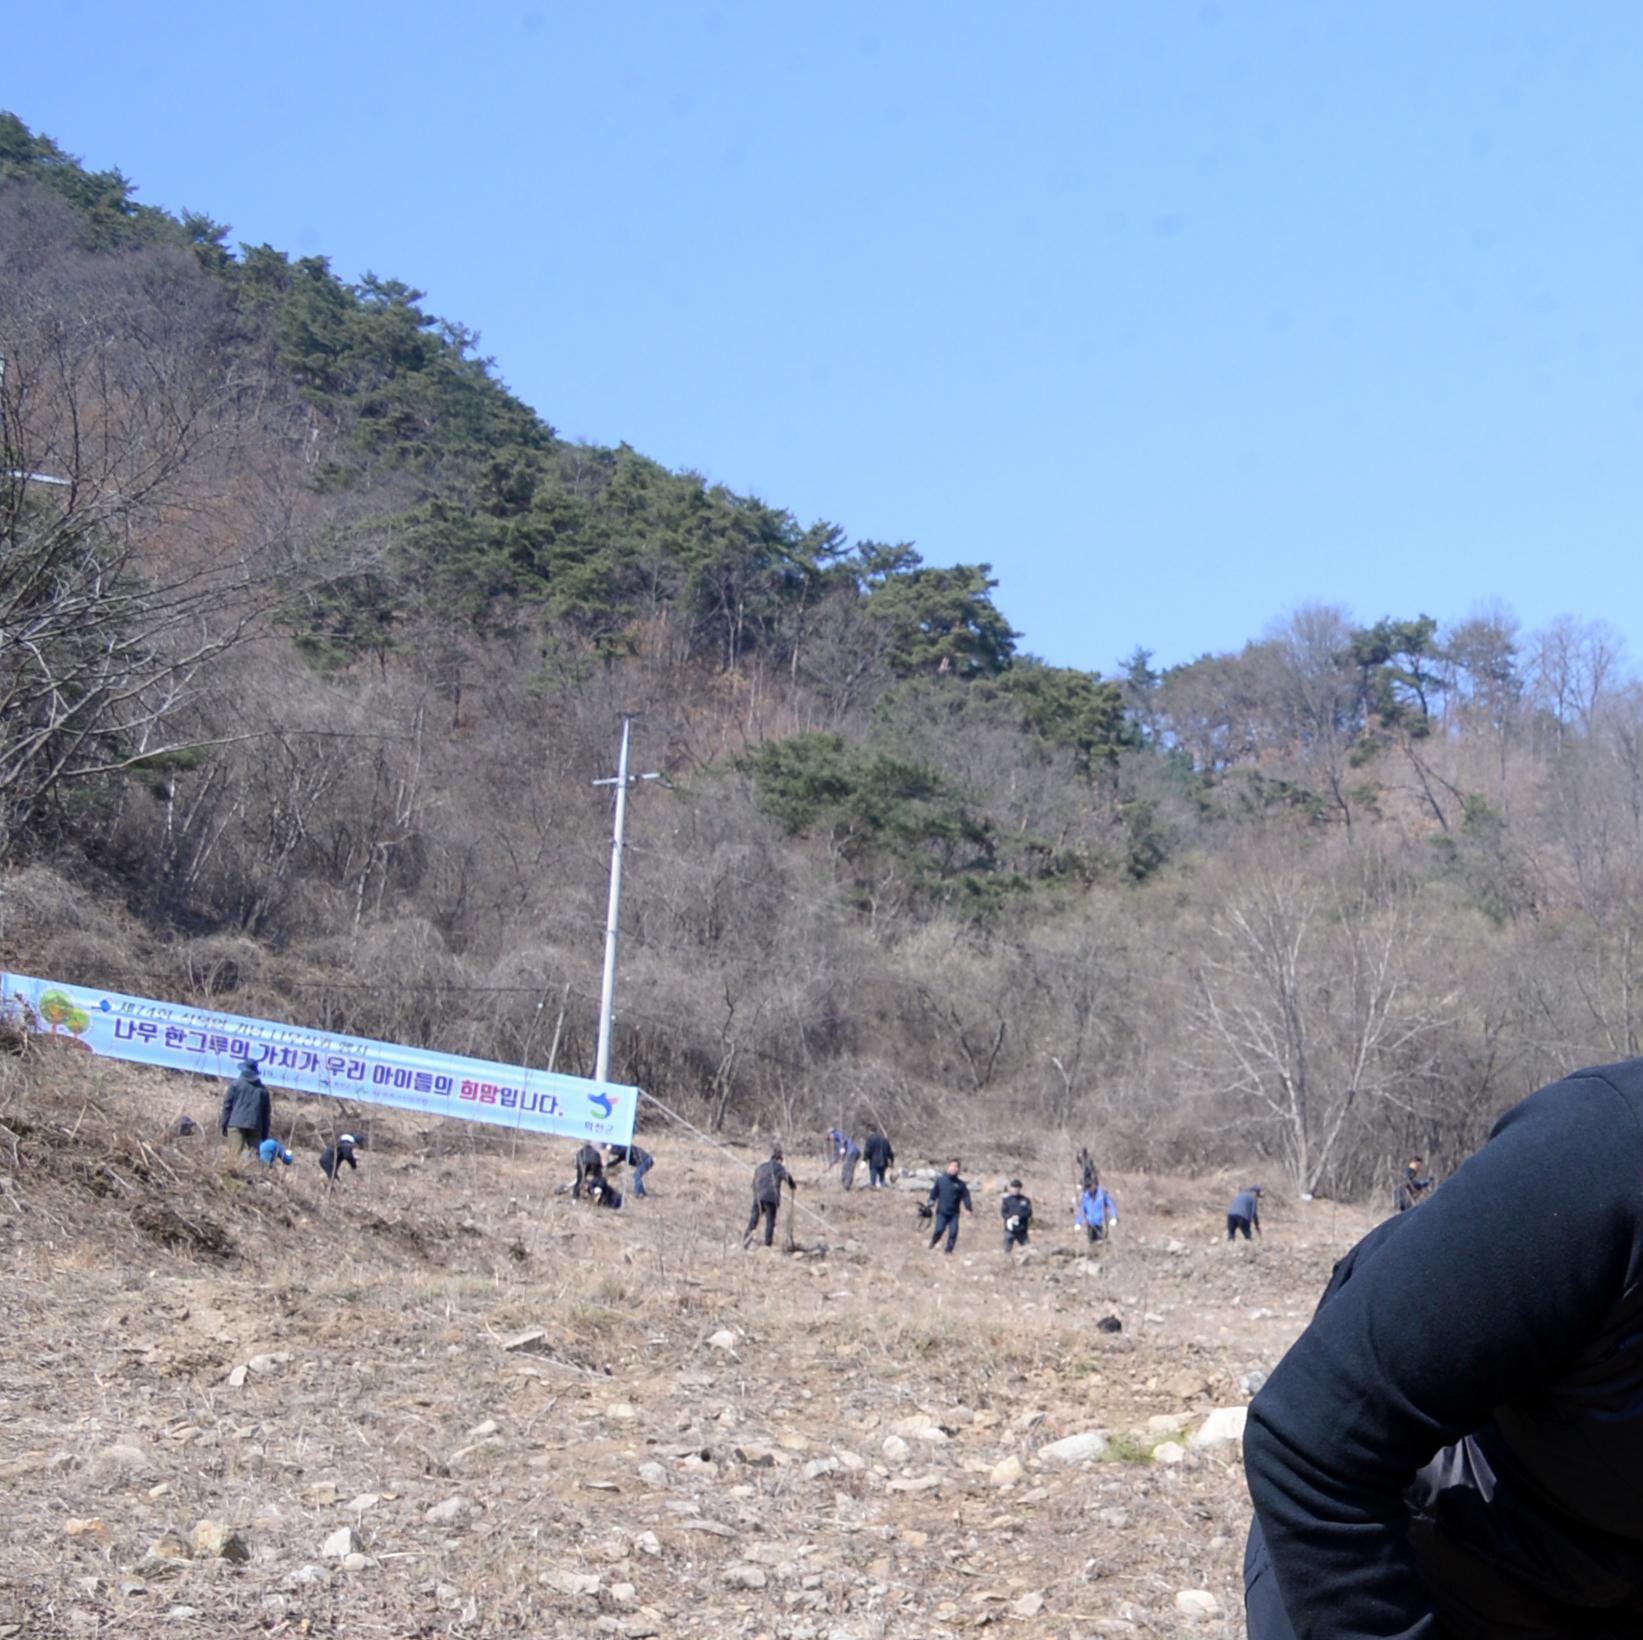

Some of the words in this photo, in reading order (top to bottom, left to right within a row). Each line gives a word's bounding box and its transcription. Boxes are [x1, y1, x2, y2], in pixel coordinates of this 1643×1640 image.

[114, 1018, 158, 1044] 나무
[164, 1025, 250, 1061] 한그루의
[257, 1043, 319, 1073] 가치가
[327, 1056, 366, 1081] 우리
[372, 1064, 454, 1097] 아이들의
[459, 1079, 563, 1118] 희망입니다.
